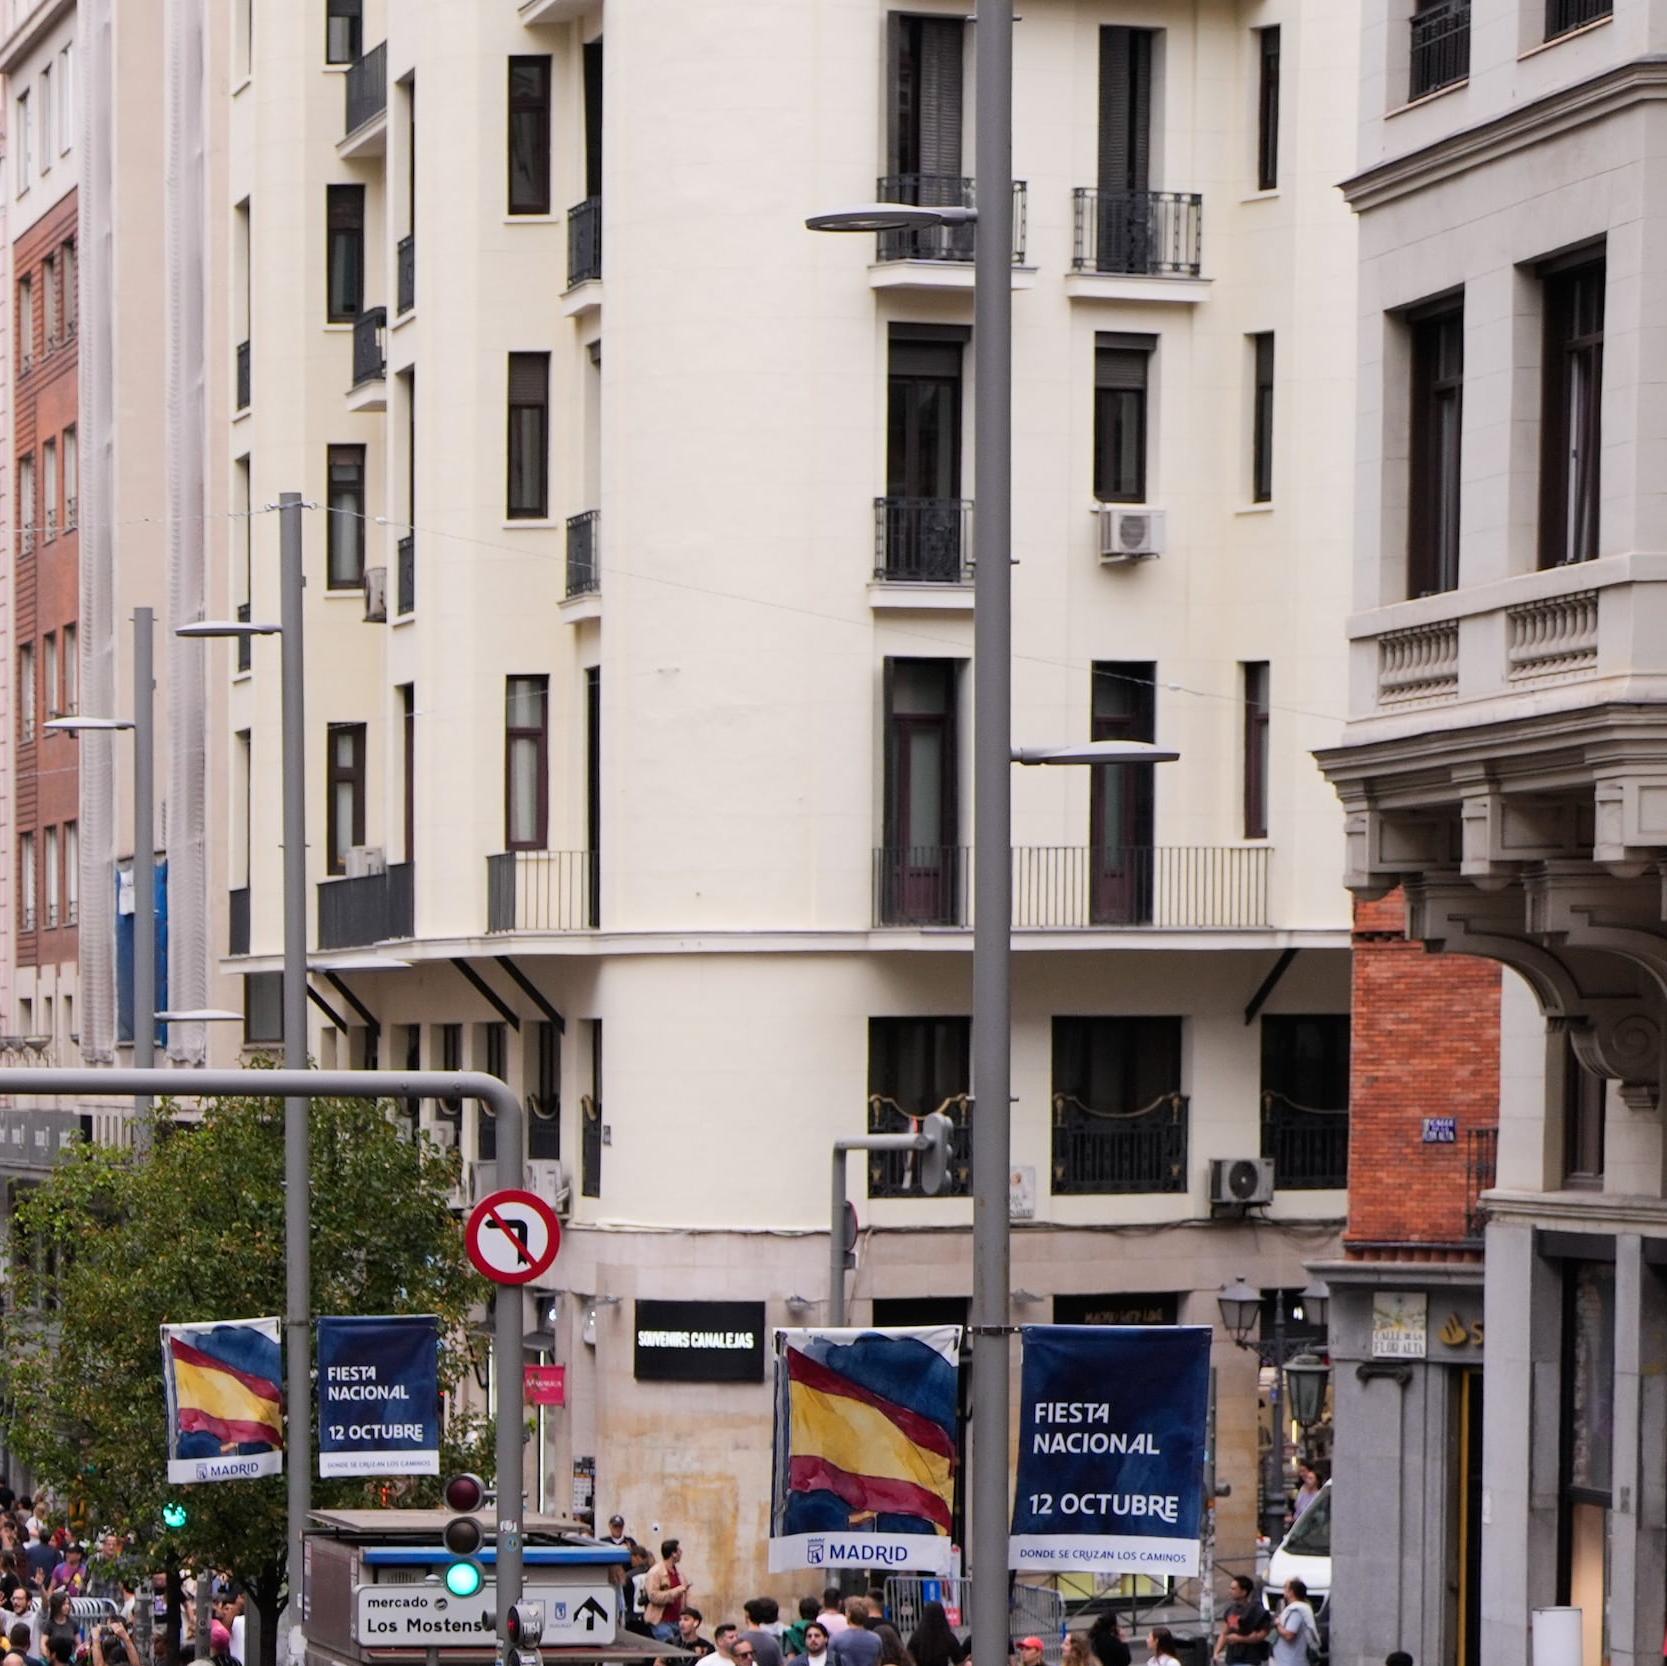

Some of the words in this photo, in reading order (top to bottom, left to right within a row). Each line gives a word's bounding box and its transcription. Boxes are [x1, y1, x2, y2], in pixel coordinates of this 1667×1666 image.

[638, 1331, 690, 1348] SOUVENIRS
[690, 1331, 754, 1349] CANALEJAS
[1374, 1332, 1400, 1341] CALLE
[328, 1366, 376, 1381] FIESTA
[328, 1385, 409, 1400] NACIONAL
[1035, 1402, 1109, 1423] FIESTA
[329, 1425, 345, 1439] 12
[350, 1424, 423, 1442] OCTUBRE
[1033, 1433, 1160, 1454] NACIONAL
[210, 1462, 259, 1475] MADRID
[1029, 1494, 1052, 1514] 12
[1061, 1494, 1179, 1523] OCTUBRE
[829, 1544, 908, 1564] MADRID
[1019, 1549, 1055, 1559] DONDE
[1058, 1550, 1070, 1560] SE
[1072, 1550, 1113, 1561] CRUZAN
[1116, 1551, 1137, 1561] LOS
[1139, 1552, 1187, 1563] CAMINOS
[367, 1597, 428, 1608] mercado
[367, 1619, 398, 1632] Los
